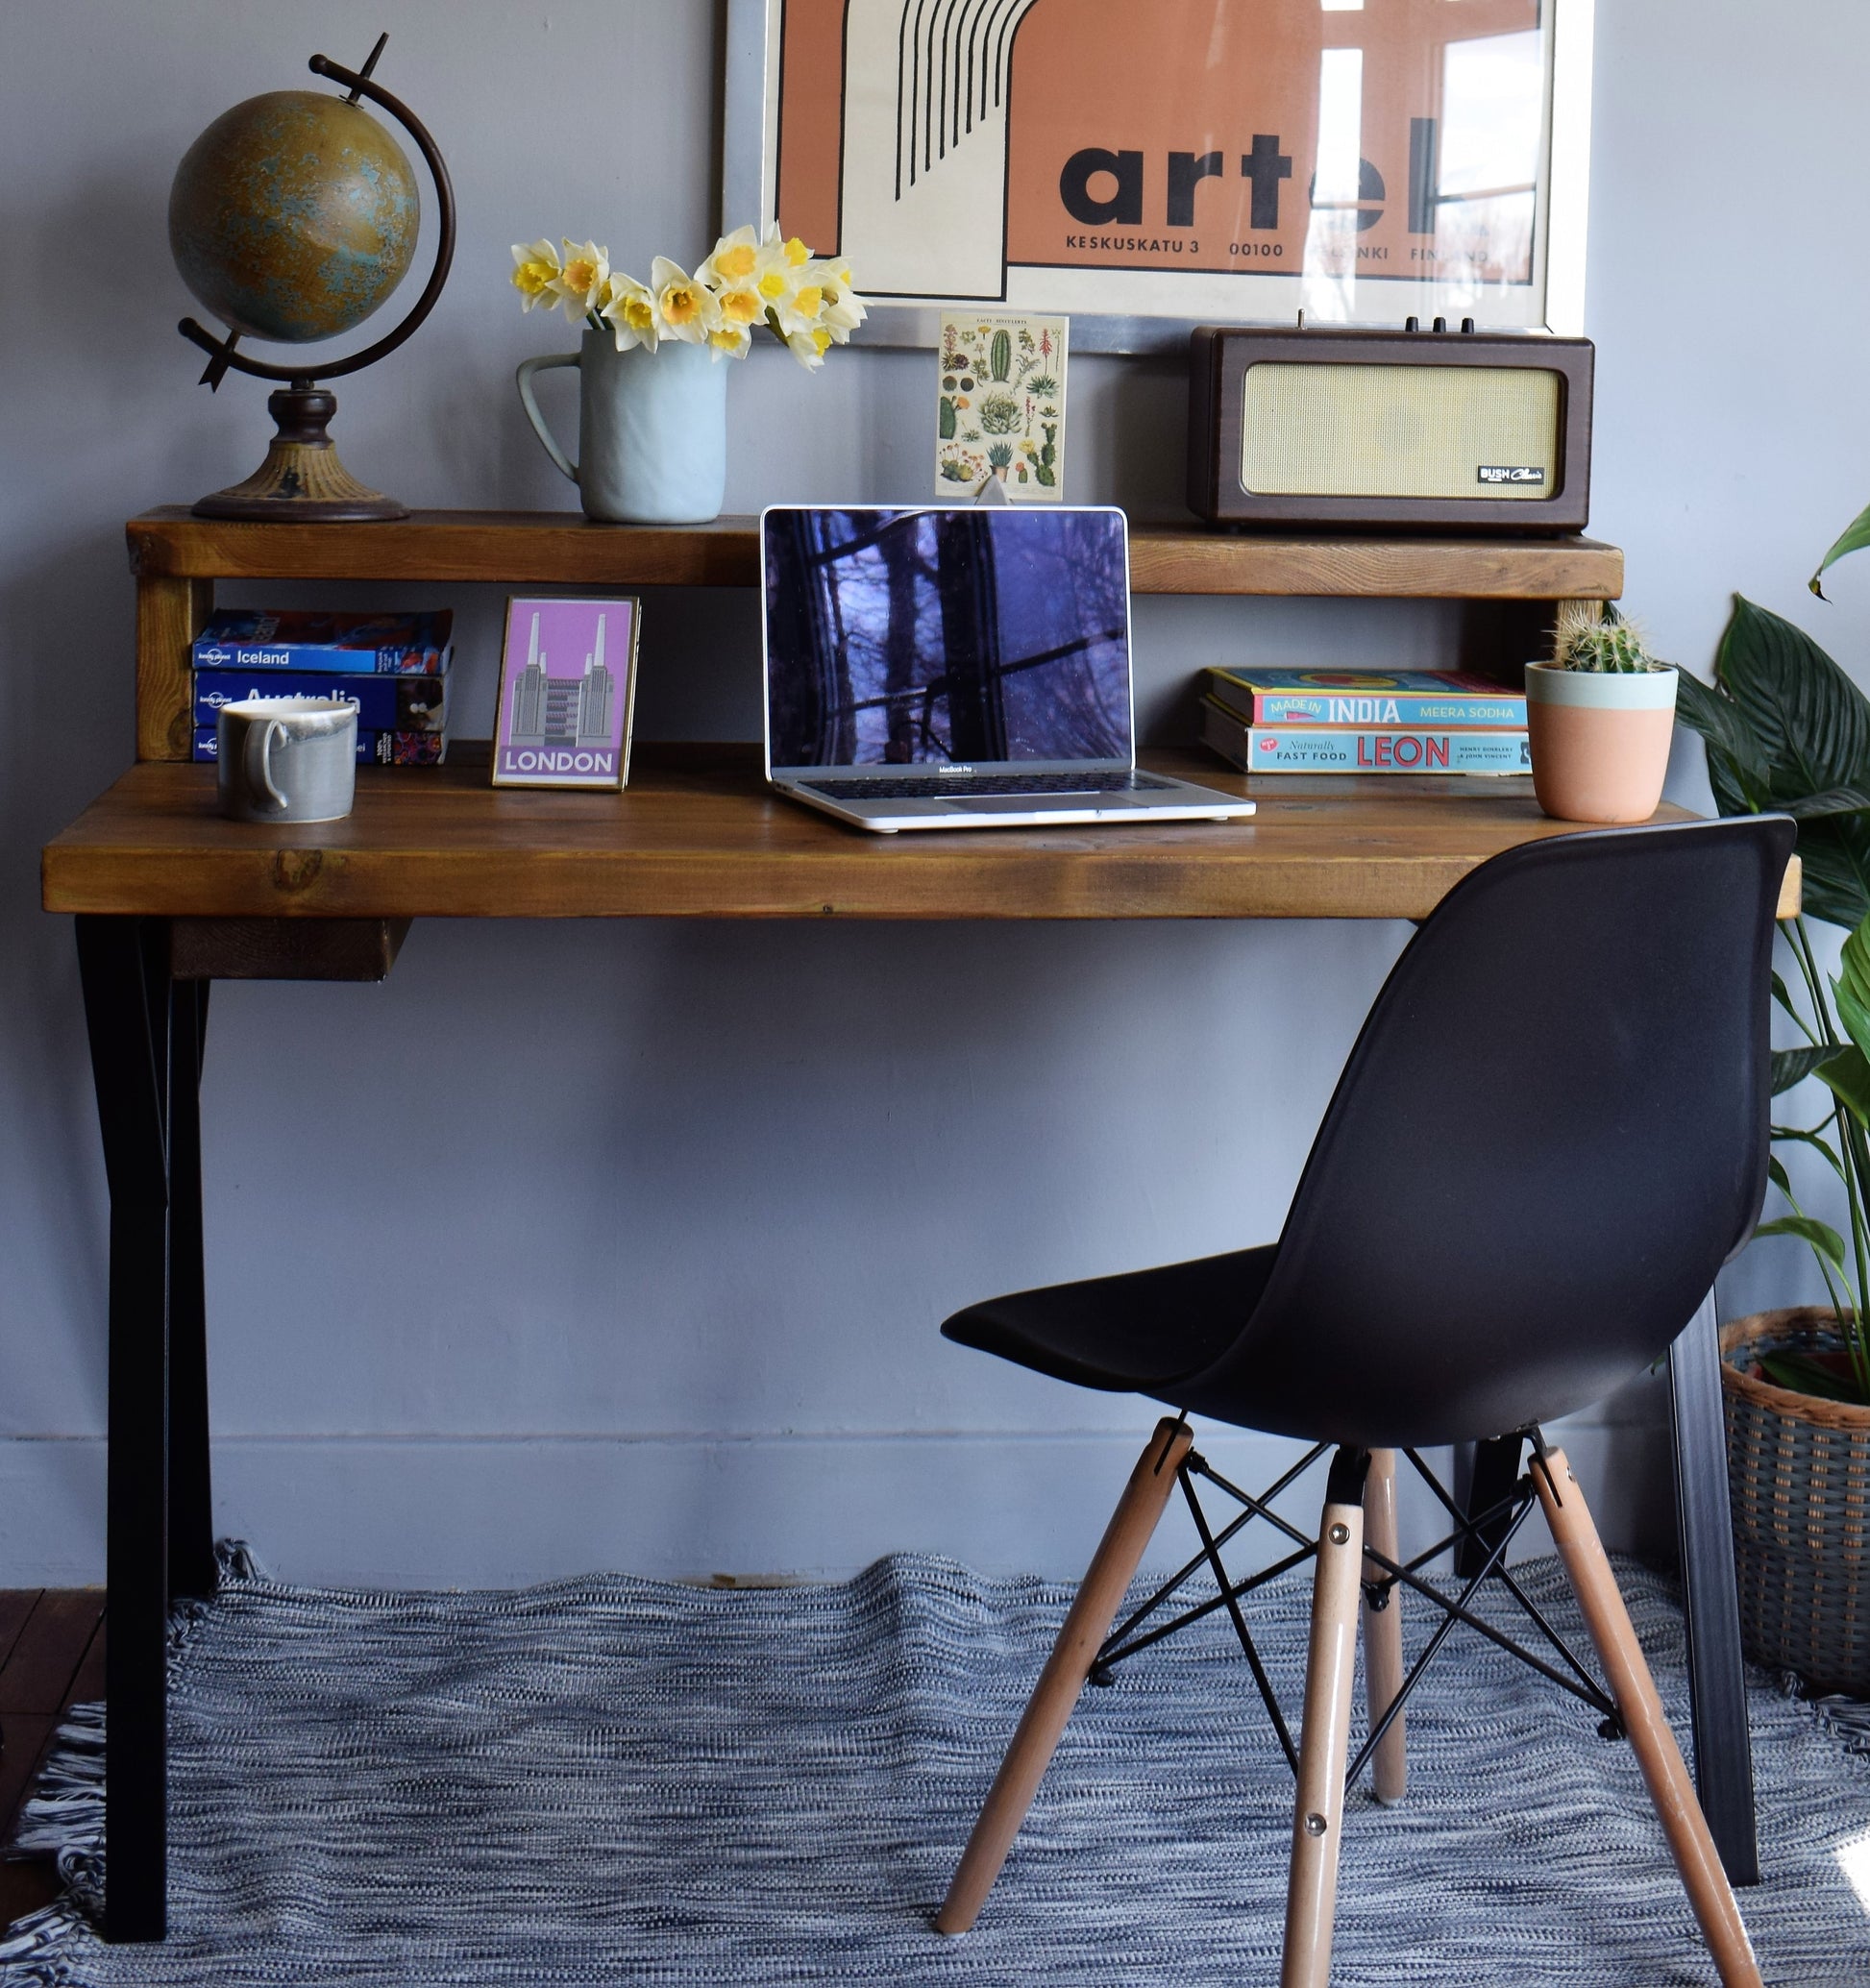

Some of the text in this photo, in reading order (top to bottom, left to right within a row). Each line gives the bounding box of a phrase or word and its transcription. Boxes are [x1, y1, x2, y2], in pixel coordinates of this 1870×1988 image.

[1066, 235, 1183, 253] KESKUSKATU
[1190, 241, 1199, 253] 3
[1229, 242, 1284, 257] 00100
[1411, 248, 1489, 262] FINND
[1480, 468, 1542, 480] BUSH Classic
[236, 650, 289, 665] Iceland
[247, 688, 361, 714] Atlia
[1270, 699, 1322, 715] MADE IN
[1328, 698, 1402, 724] INDIA
[1419, 706, 1514, 719] MEERA SODHA
[1289, 739, 1335, 751] Naturally
[1356, 736, 1450, 768] LEON
[504, 750, 613, 773] LONDON
[1276, 752, 1347, 761] FAST FOOD
